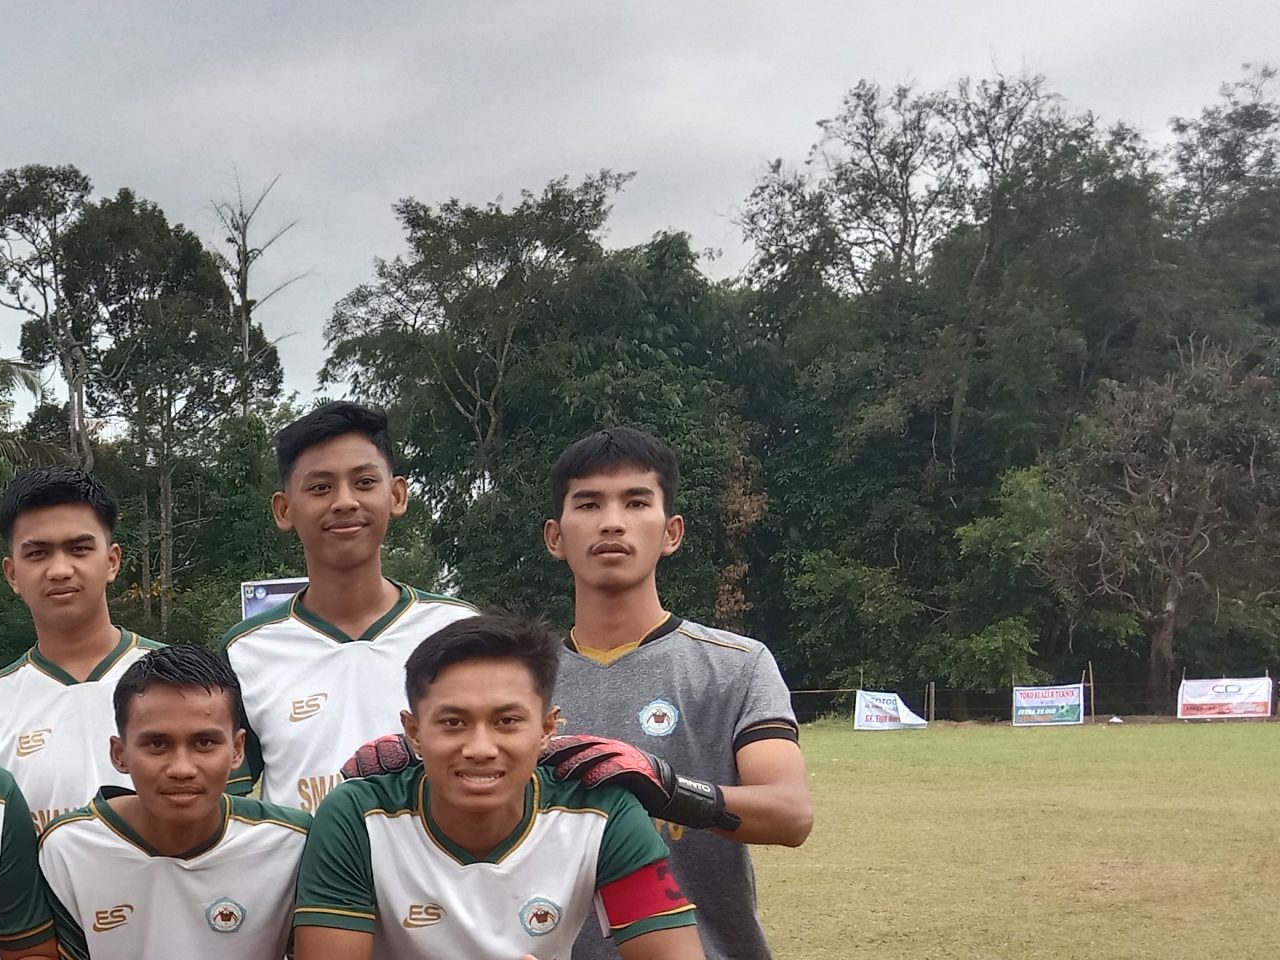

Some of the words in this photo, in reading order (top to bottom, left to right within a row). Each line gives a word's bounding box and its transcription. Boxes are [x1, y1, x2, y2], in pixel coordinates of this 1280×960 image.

[291, 696, 322, 717] ES
[18, 731, 47, 751] ES
[94, 906, 128, 927] ES
[407, 903, 443, 923] ES
